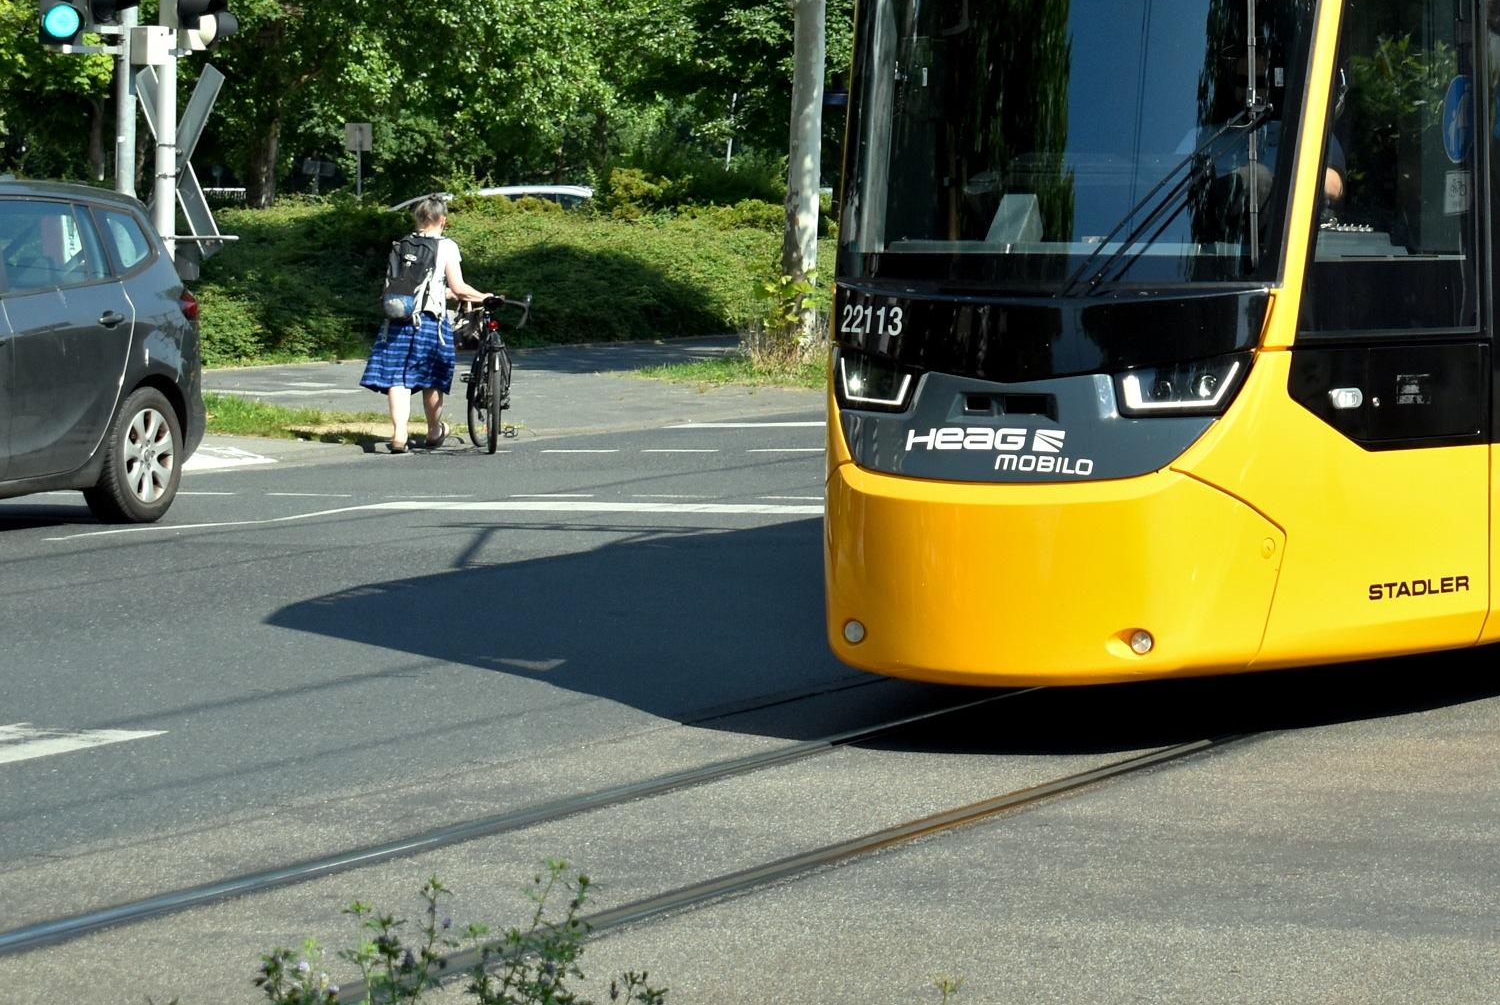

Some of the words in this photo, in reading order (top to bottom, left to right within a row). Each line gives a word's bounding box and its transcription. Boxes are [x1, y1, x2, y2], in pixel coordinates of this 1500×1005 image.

[841, 304, 903, 336] 22113
[994, 454, 1094, 476] MOBILO
[1368, 575, 1470, 601] STADLER
